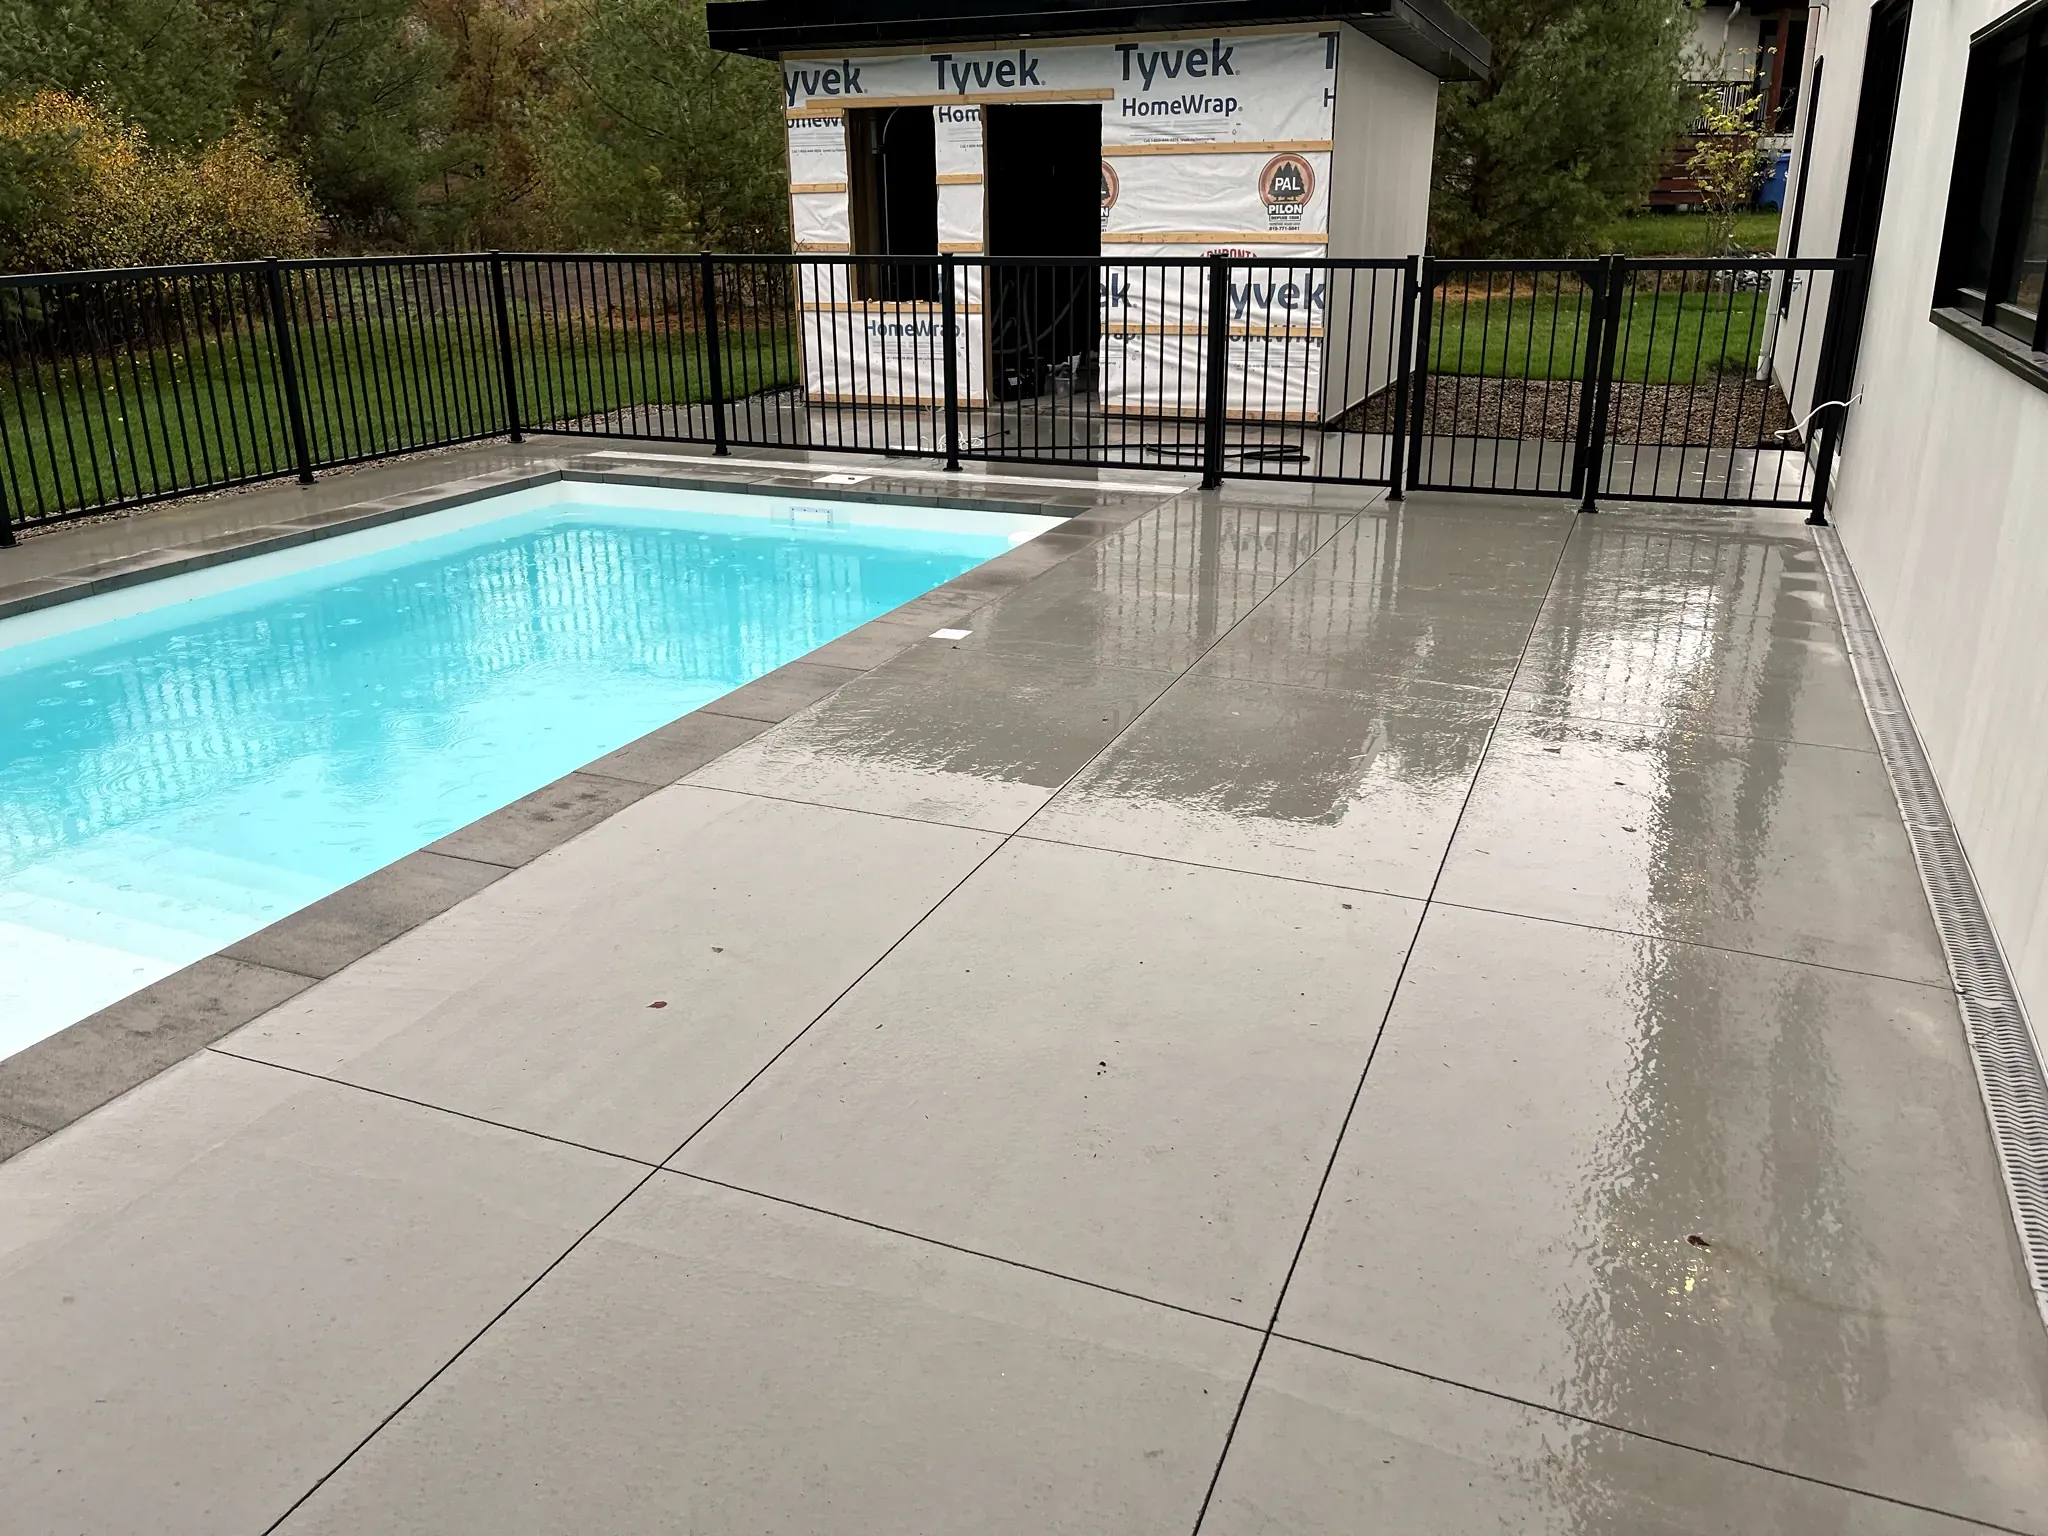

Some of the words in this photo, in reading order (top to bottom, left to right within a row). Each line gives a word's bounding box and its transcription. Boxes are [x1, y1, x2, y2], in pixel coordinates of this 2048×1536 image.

[930, 49, 1040, 95] Tyvek
[1115, 38, 1234, 91] Tyvek
[1122, 94, 1238, 117] HomeWrap
[1274, 176, 1301, 191] PAL
[1268, 204, 1303, 214] PILON
[1207, 273, 1325, 319] yvek
